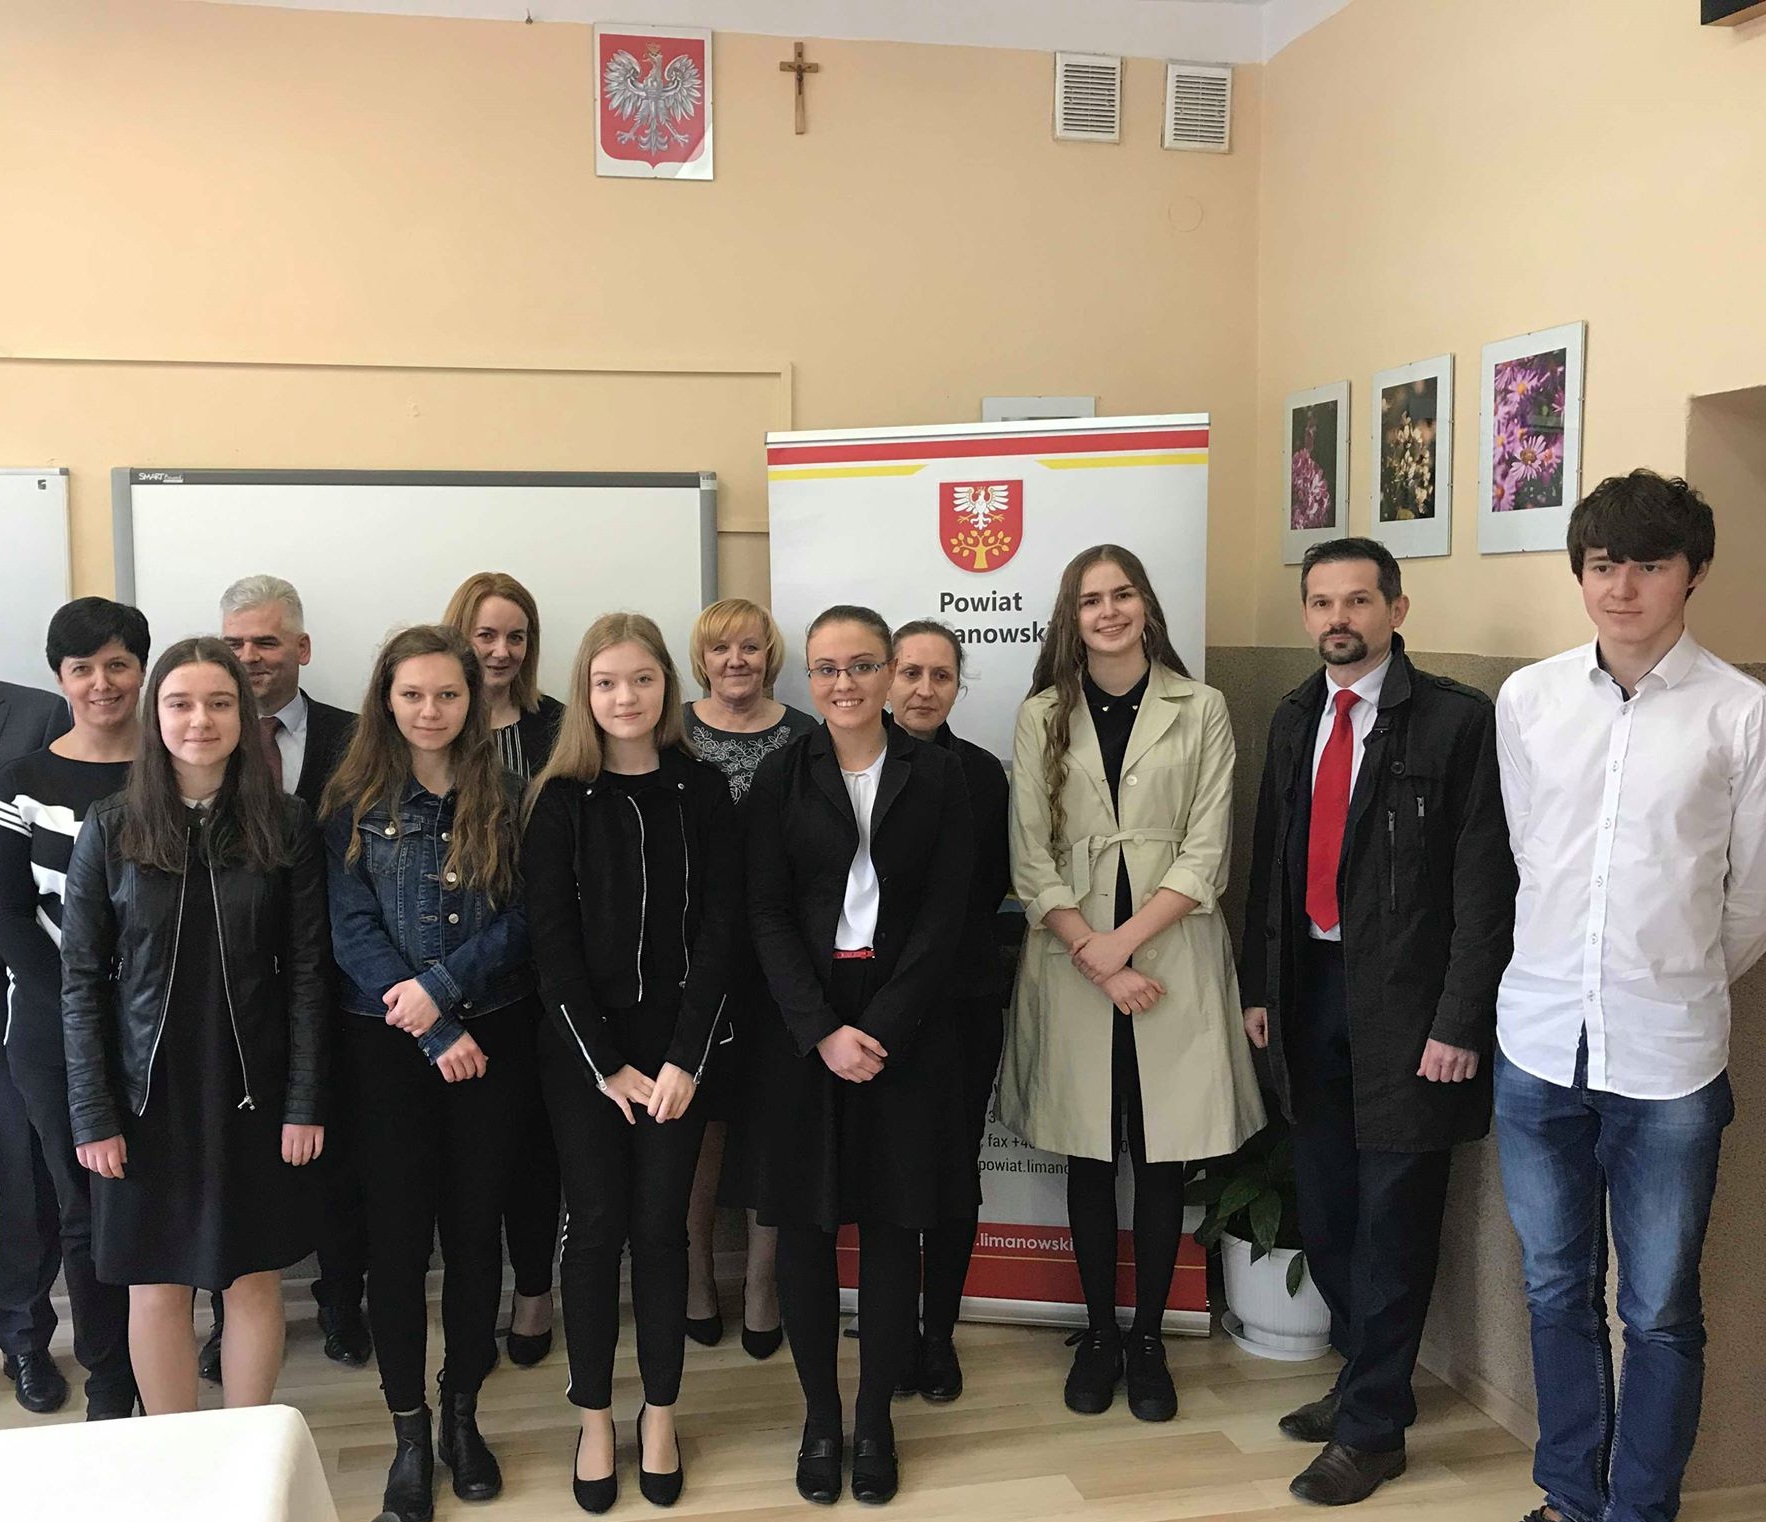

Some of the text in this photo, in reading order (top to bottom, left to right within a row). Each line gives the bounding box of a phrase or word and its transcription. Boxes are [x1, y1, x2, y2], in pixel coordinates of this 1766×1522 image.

[138, 472, 165, 481] SMART
[939, 589, 1023, 613] Powiat
[954, 620, 1052, 644] anowsk
[988, 1133, 1008, 1149] fax
